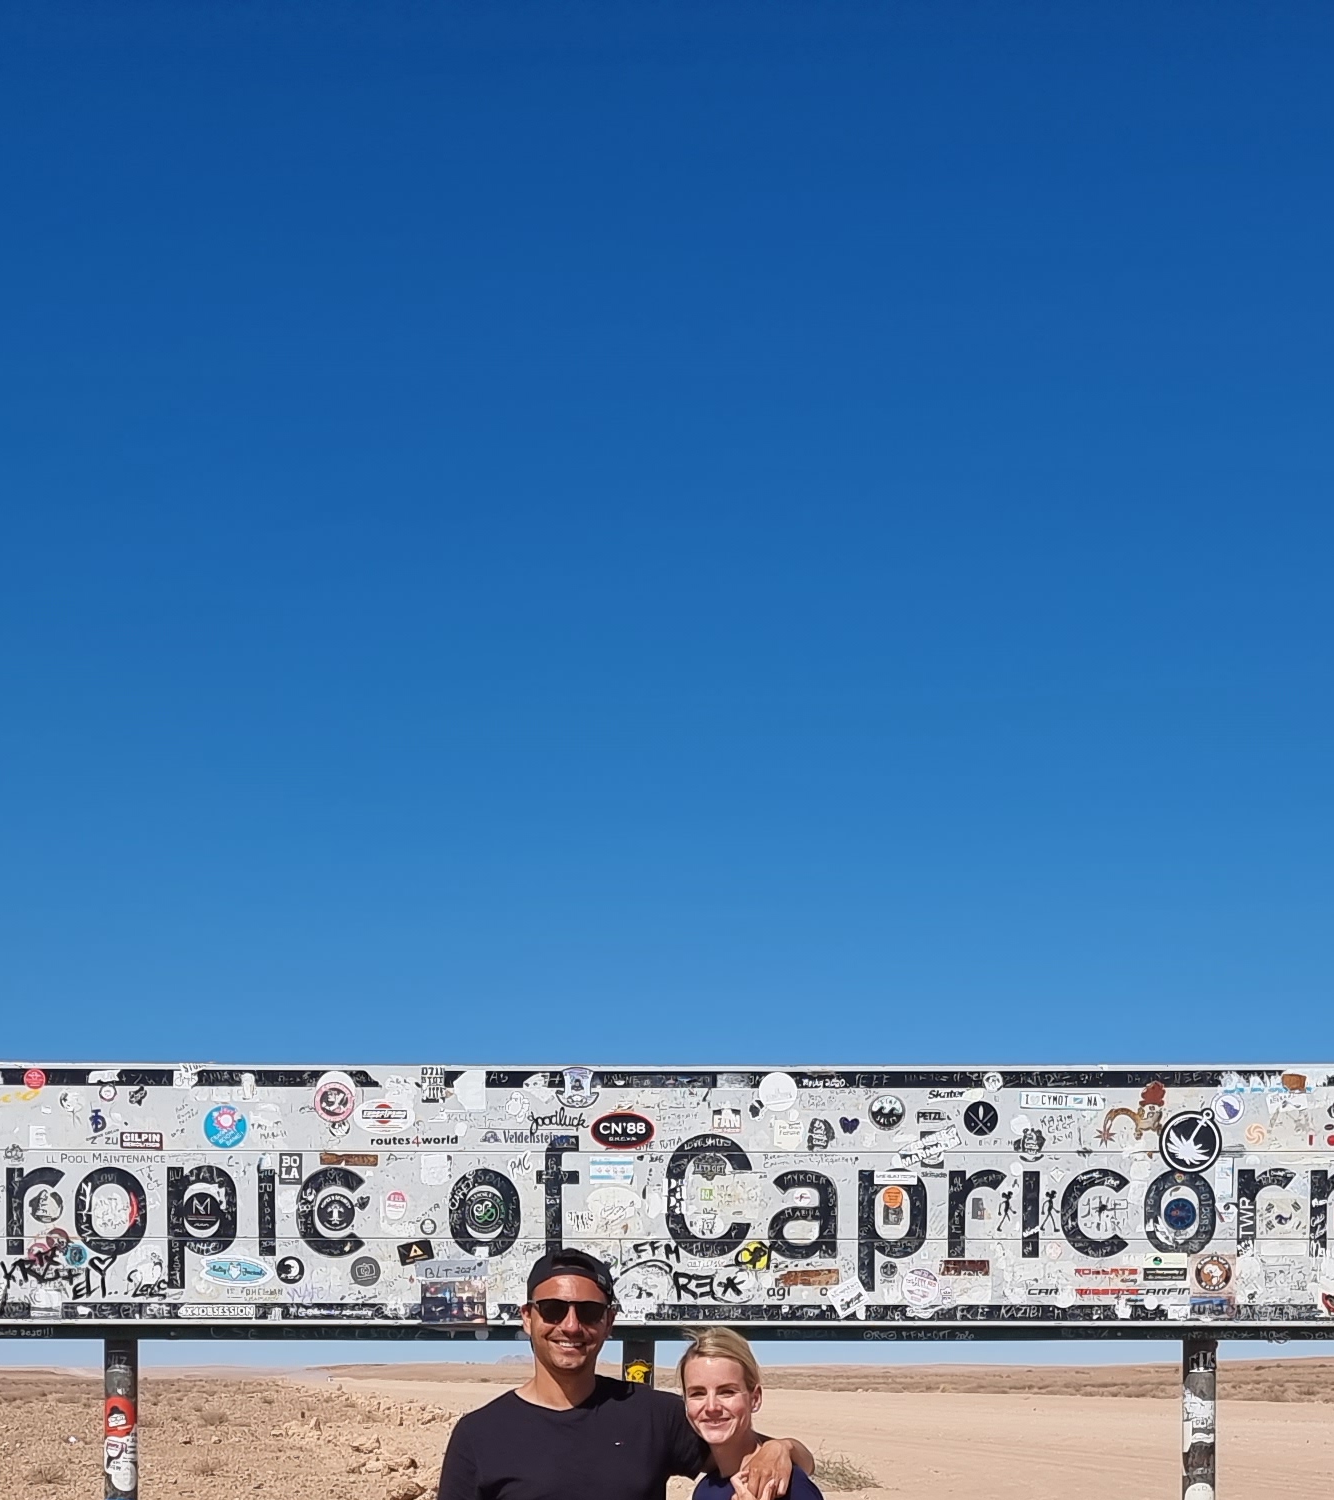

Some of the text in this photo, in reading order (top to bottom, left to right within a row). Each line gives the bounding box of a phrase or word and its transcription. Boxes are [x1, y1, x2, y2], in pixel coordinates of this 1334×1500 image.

[1041, 1094, 1069, 1105] CYMOT
[599, 1122, 646, 1134] CN'88
[122, 1133, 161, 1142] GILPIN
[370, 1135, 458, 1147] routes4world
[281, 1155, 300, 1167] BO
[281, 1168, 300, 1179] LA
[449, 1134, 581, 1259] of
[1239, 1197, 1254, 1236] TWR
